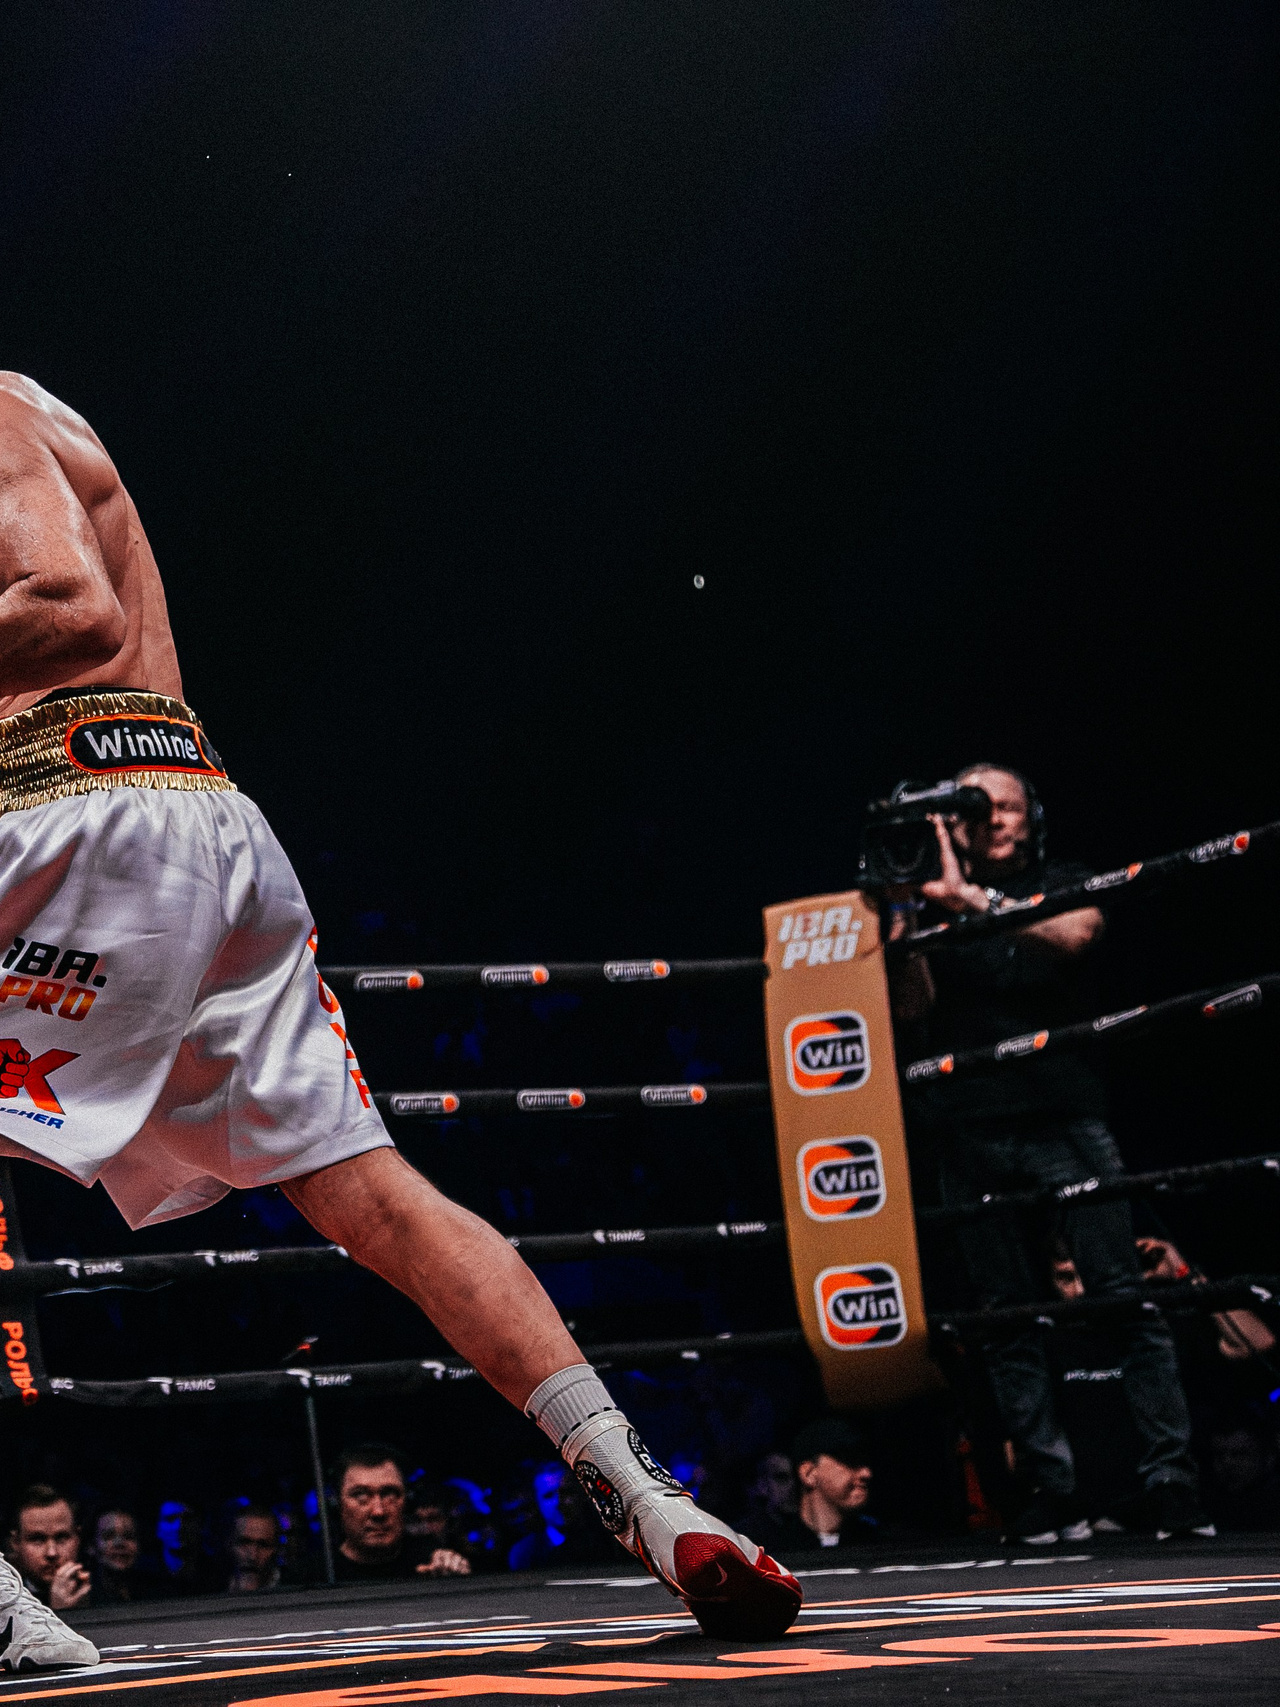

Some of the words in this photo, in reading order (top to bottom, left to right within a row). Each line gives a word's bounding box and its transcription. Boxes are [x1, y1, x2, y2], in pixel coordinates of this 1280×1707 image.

[84, 727, 199, 760] Winline
[781, 933, 859, 970] PRO
[805, 1040, 863, 1068] Win
[818, 1165, 878, 1194] Win
[835, 1294, 898, 1322] Win
